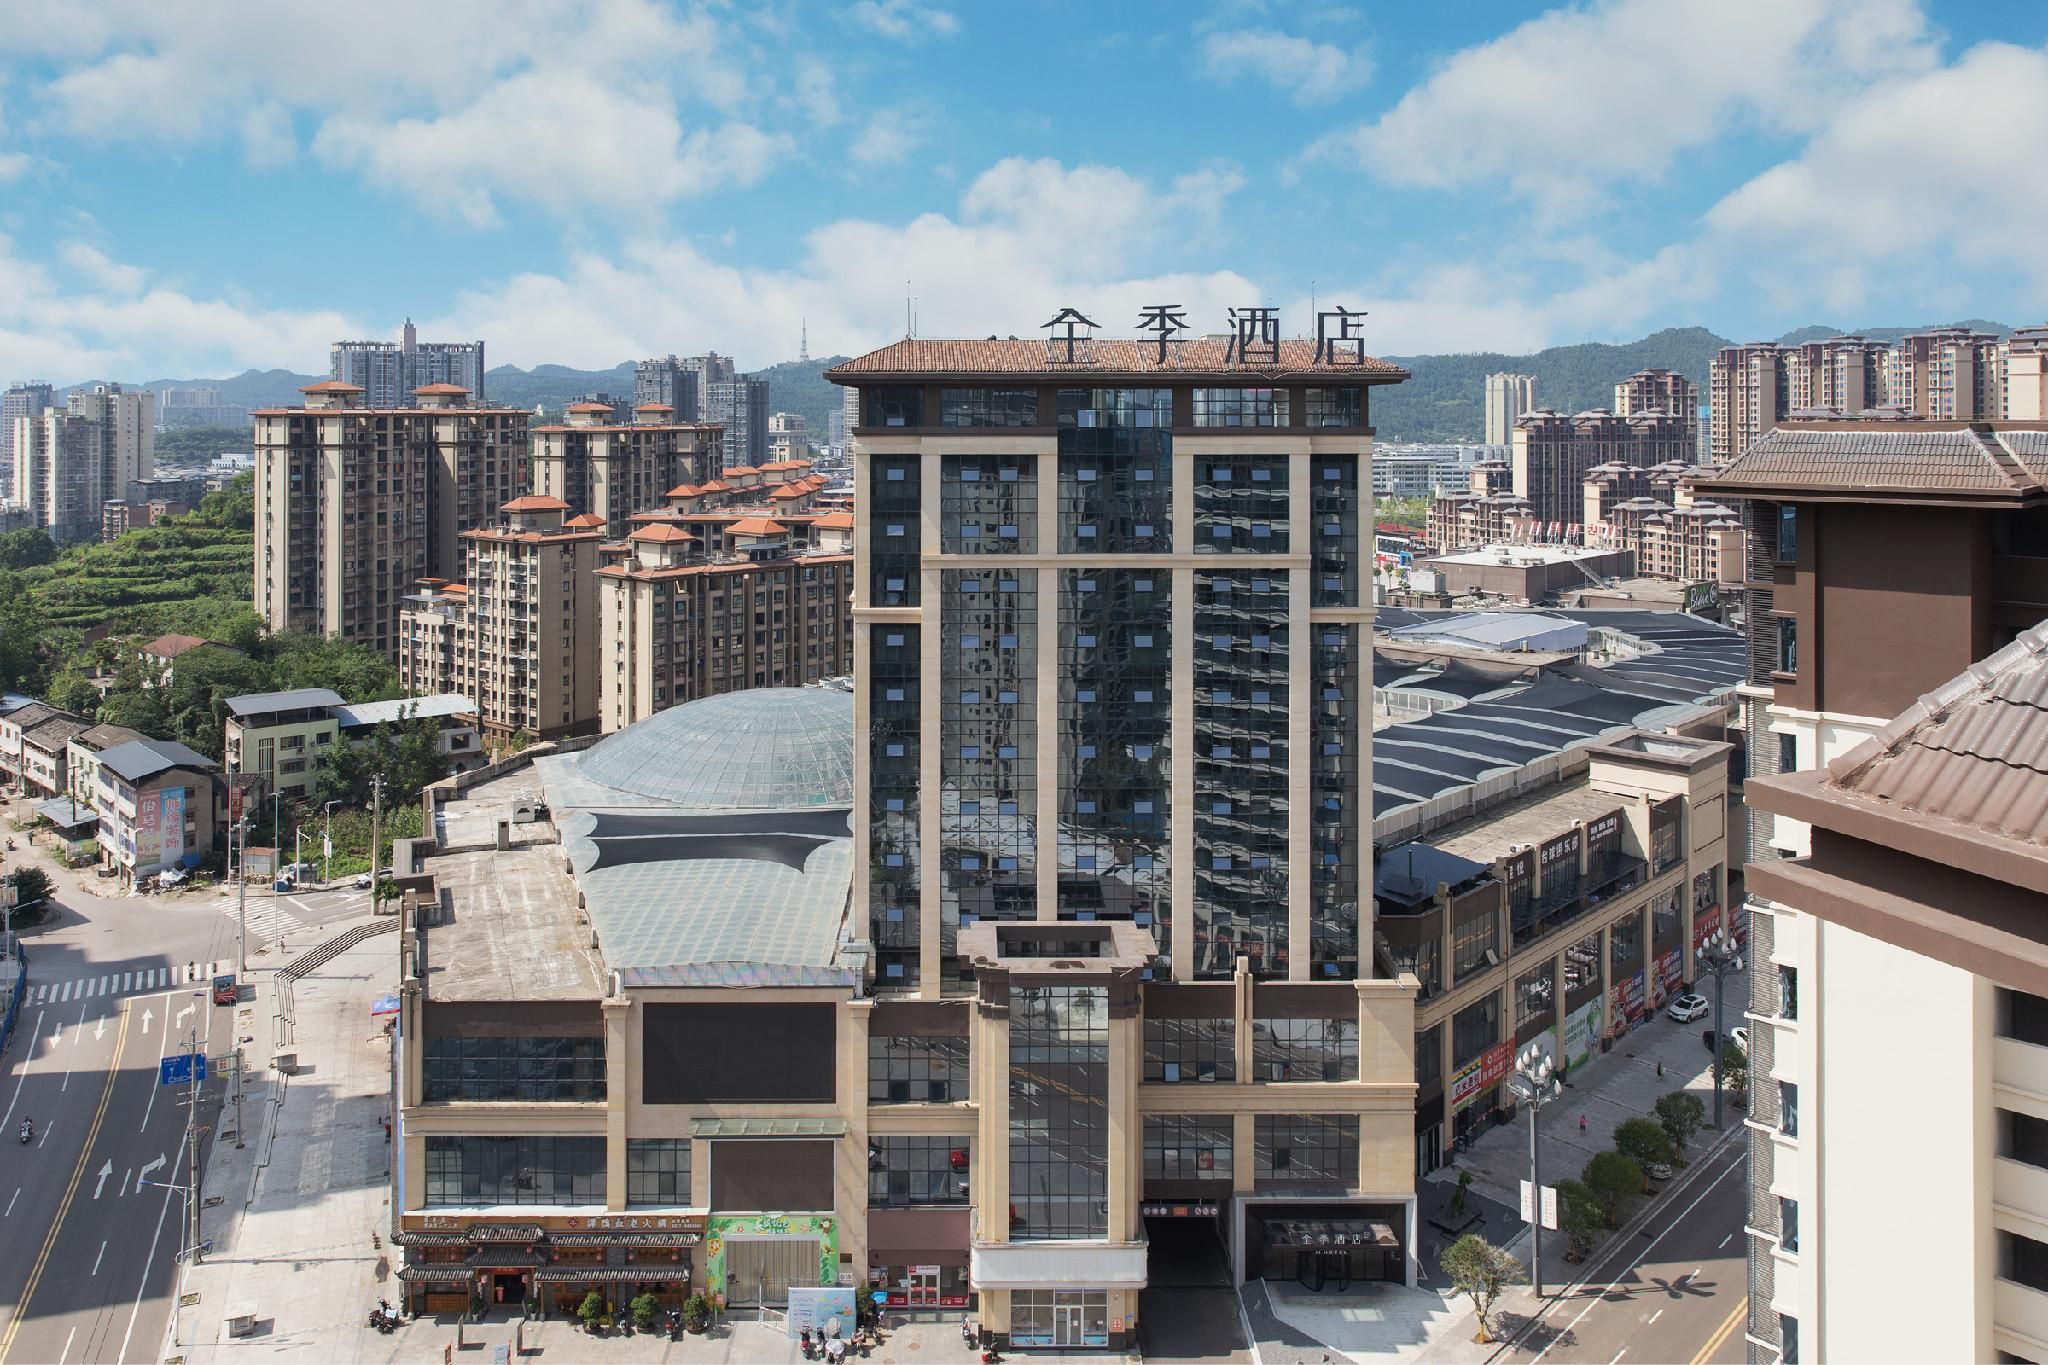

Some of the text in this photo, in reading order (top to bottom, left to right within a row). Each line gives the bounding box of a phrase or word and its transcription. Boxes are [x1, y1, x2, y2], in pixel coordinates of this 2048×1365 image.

[1040, 305, 1369, 365] 全季酒店
[1541, 836, 1579, 864] 台球俱乐部
[1302, 1233, 1361, 1245] 全季酒店
